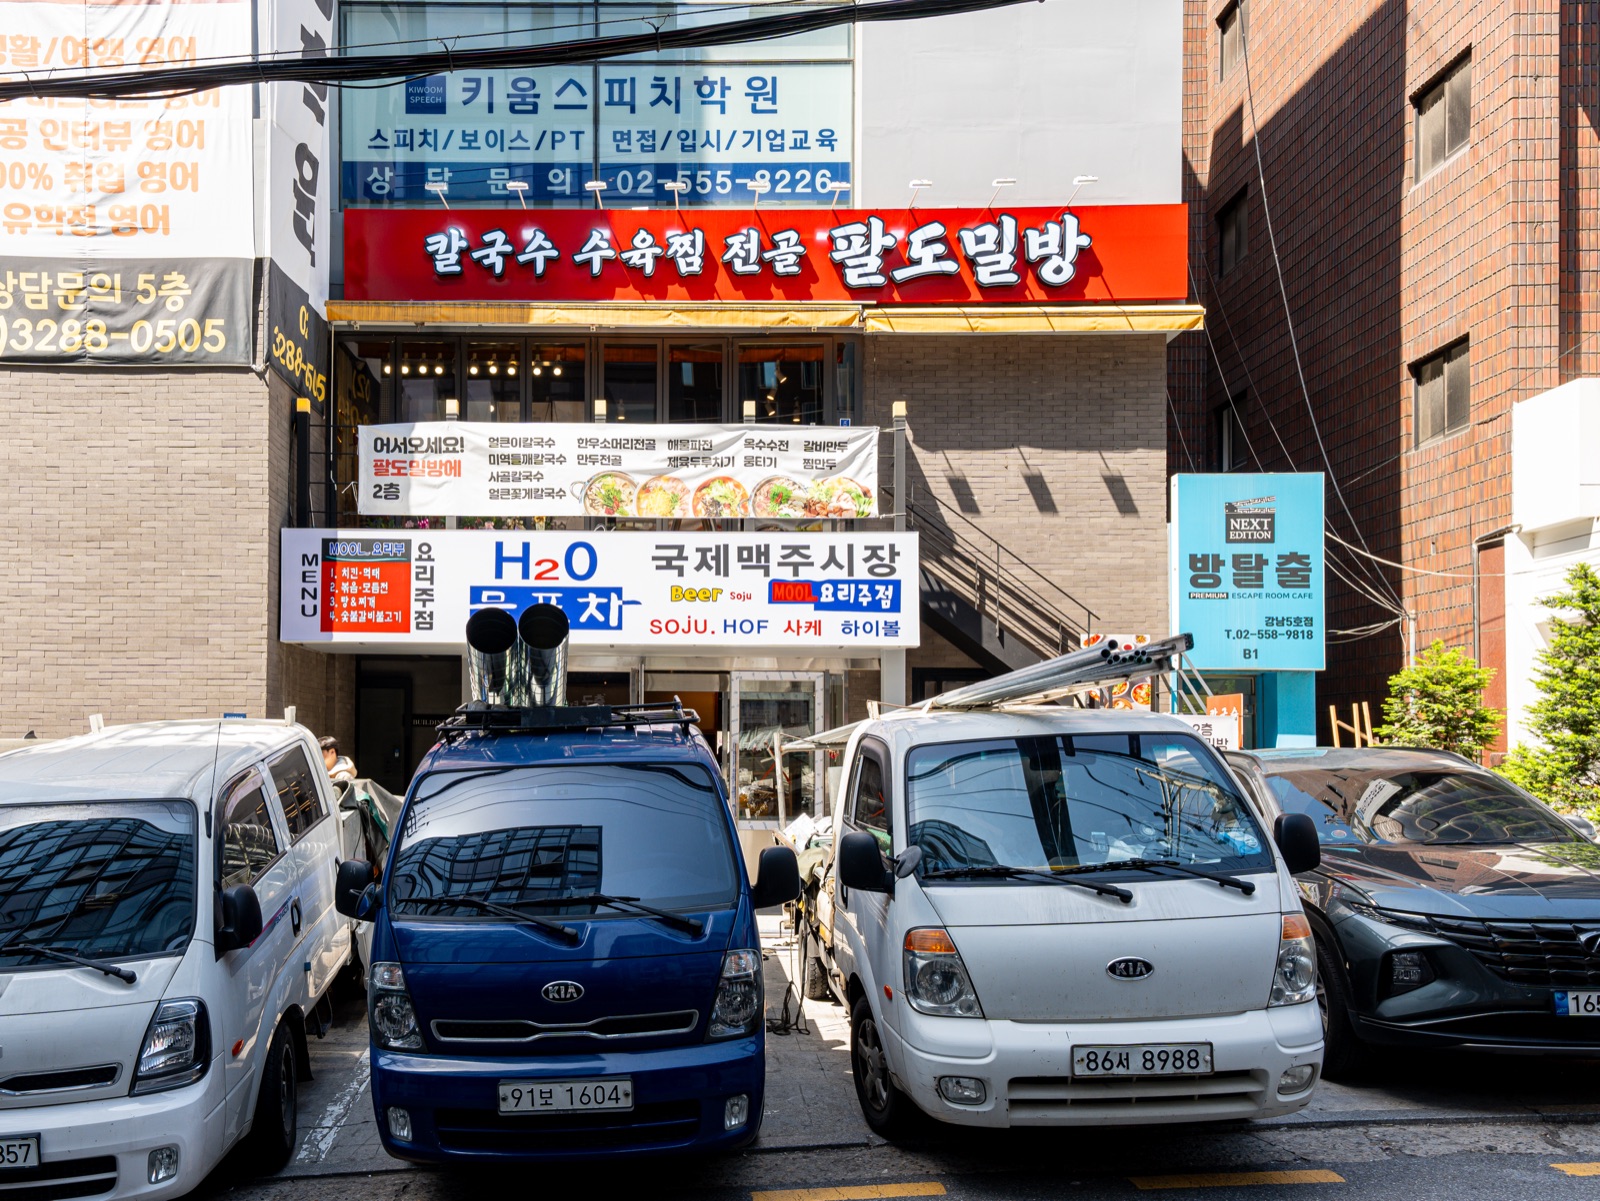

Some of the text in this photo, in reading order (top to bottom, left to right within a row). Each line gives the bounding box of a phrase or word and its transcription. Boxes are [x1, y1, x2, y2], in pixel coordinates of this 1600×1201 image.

[0, 35, 196, 69] 활/여행 영어
[408, 86, 443, 94] KIWOOM
[410, 95, 442, 104] SPEECH
[461, 75, 780, 115] 키움스피치학원
[40, 119, 133, 151] 인터뷰
[144, 119, 205, 151] 영어
[367, 127, 839, 153] 스피치/보이스/PT 면접/입시/기업교육
[64, 161, 125, 194] 취업
[137, 161, 199, 193] 영어
[616, 168, 832, 195] 02-555-8226
[108, 203, 170, 237] 영어
[424, 213, 1092, 289] 칼국수 수육찜 전골 팔도밀방
[0, 271, 192, 312] 상담문의 5층
[373, 436, 465, 455] 어서오세요!
[576, 437, 656, 450] 한우소머리전골
[667, 439, 713, 451] 해물파전
[743, 438, 790, 452] 옥수수전
[803, 440, 848, 453] 갈비만두
[373, 458, 461, 478] 팔도밀방에
[577, 453, 622, 466] 만두전골
[667, 456, 735, 469] 제육두루치기
[802, 457, 837, 470] 찜만두
[372, 470, 544, 501] 2층 사골칼국수
[1230, 518, 1272, 530] NEXT
[1230, 531, 1272, 539] EDITION
[372, 542, 405, 556] 요리부
[495, 541, 598, 581] H2O
[651, 543, 901, 578] 국제맥주시장
[1189, 551, 1313, 589] 방탈출
[301, 553, 320, 617] MENU
[415, 542, 435, 631] 요리주점
[670, 585, 723, 602] Beer
[730, 591, 752, 602] Soju
[820, 583, 894, 610] 요리주점
[723, 619, 769, 634] HOF
[783, 619, 822, 637] 사케
[841, 620, 901, 637] 하이볼
[1225, 629, 1314, 640] T.02-558-9818
[1265, 616, 1314, 627] 강남5호점
[1243, 648, 1259, 659] B1
[1114, 962, 1147, 976] KIA
[548, 985, 578, 999] KIA
[1142, 1048, 1200, 1071] 8988
[565, 1085, 621, 1106] 1604
